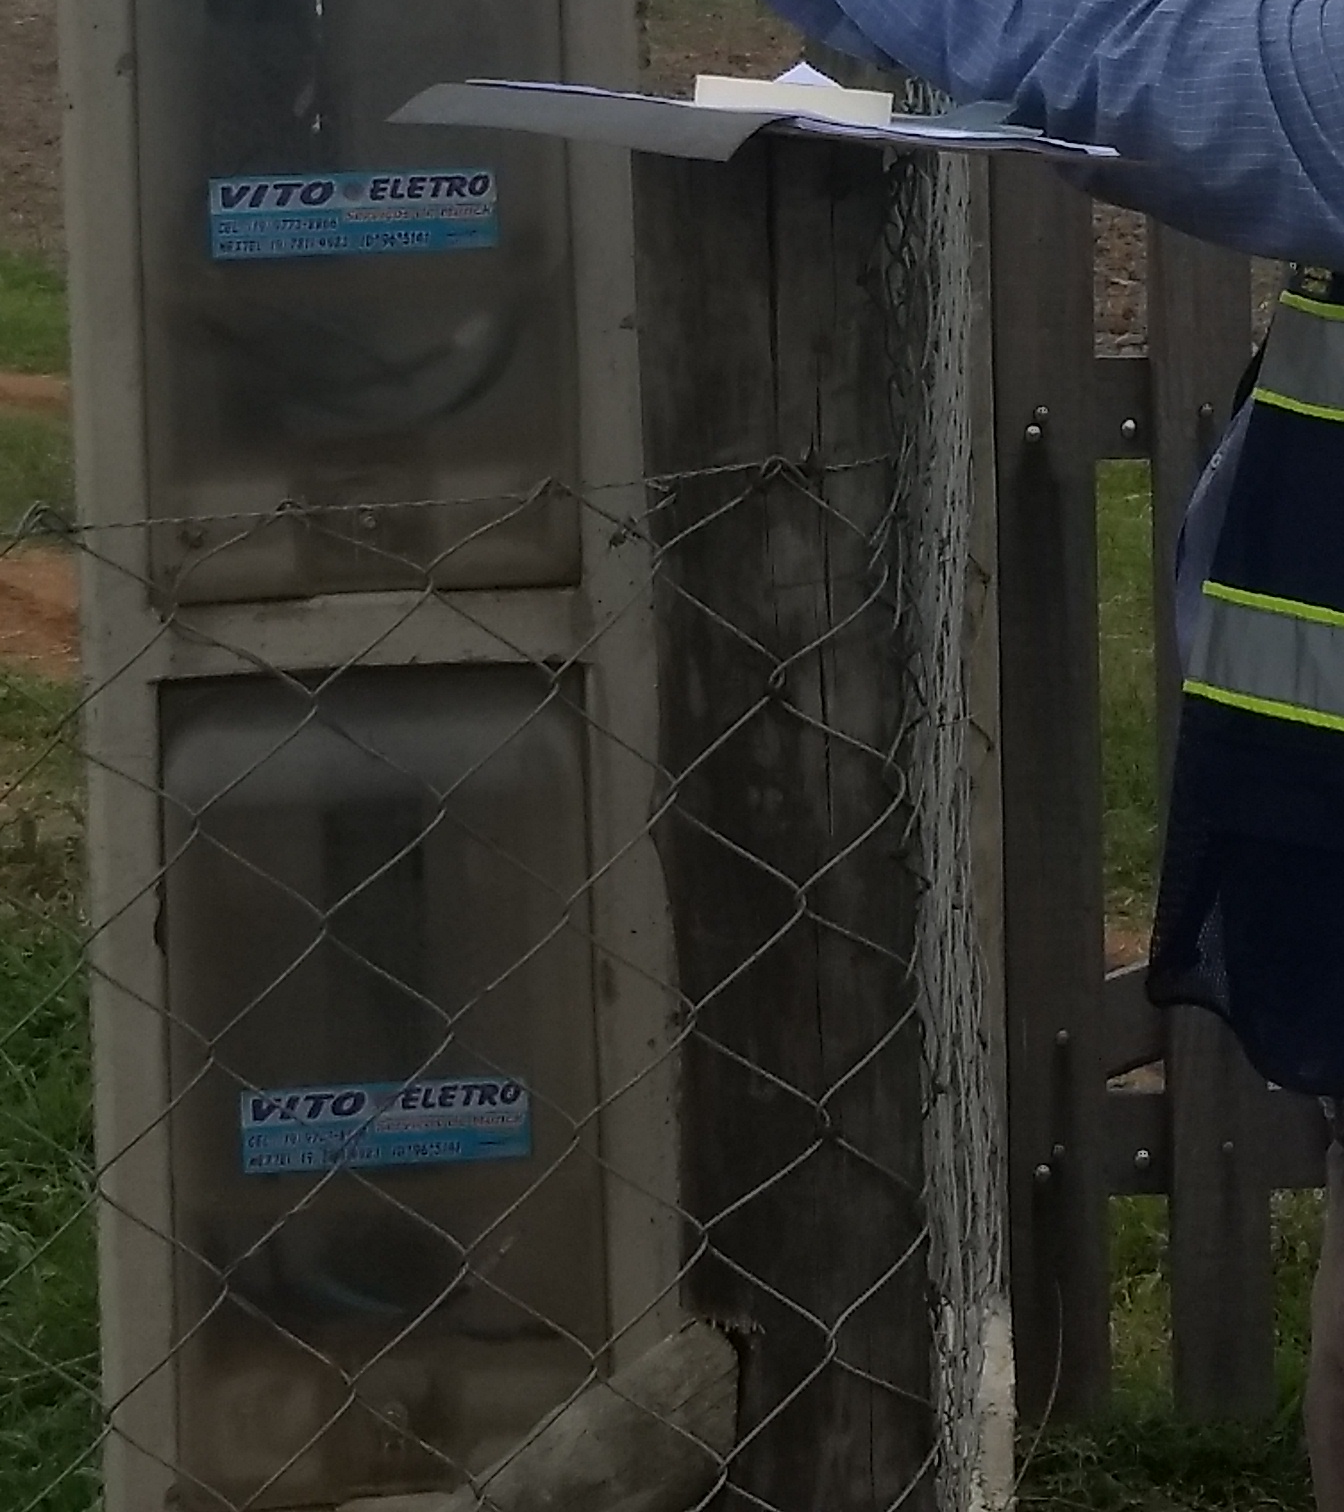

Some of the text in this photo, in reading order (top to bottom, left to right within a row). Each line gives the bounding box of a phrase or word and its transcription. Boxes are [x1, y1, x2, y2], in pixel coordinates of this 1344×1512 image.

[220, 172, 491, 209] VITO ELETRO
[251, 1090, 365, 1123] VITO
[400, 1081, 522, 1110] ELETRO
